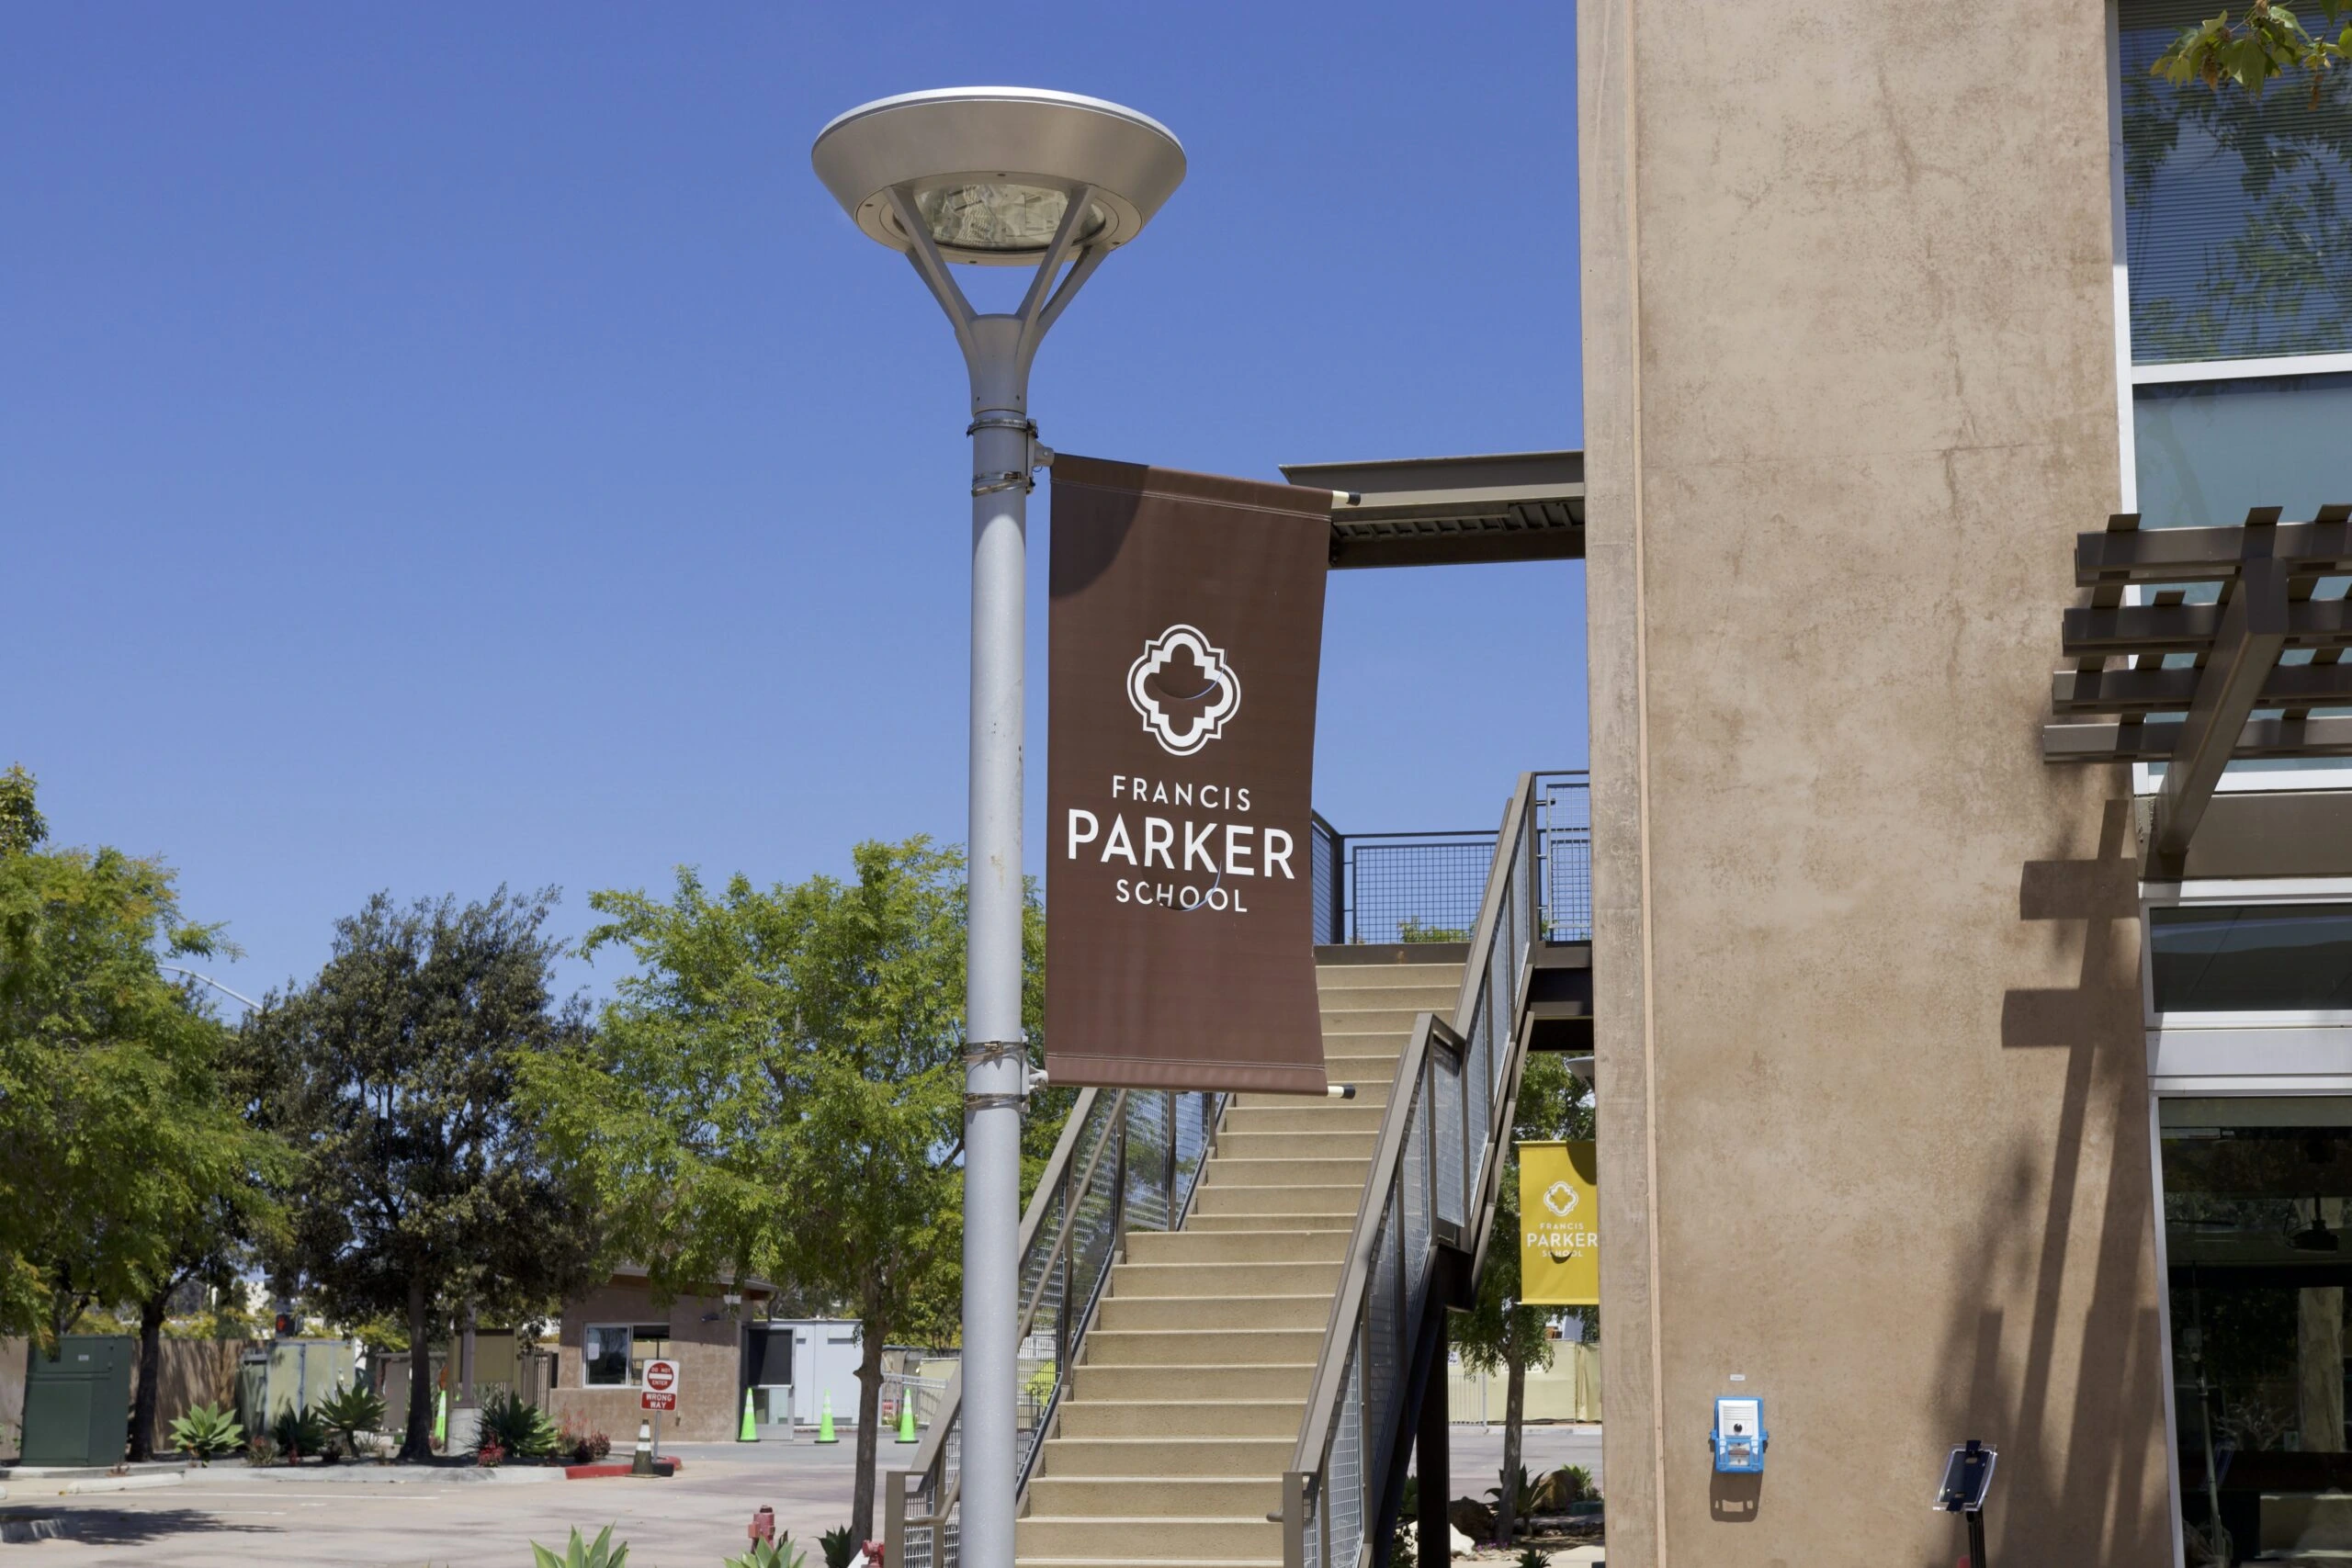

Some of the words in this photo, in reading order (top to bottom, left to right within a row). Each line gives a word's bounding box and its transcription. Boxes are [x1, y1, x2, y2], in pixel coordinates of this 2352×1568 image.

[1113, 775, 1250, 812] FRANCIS
[1068, 808, 1295, 879] PARKER
[1115, 879, 1248, 912] SCHOOL
[1527, 1233, 1599, 1247] PARKER
[646, 1393, 672, 1402] WRONG
